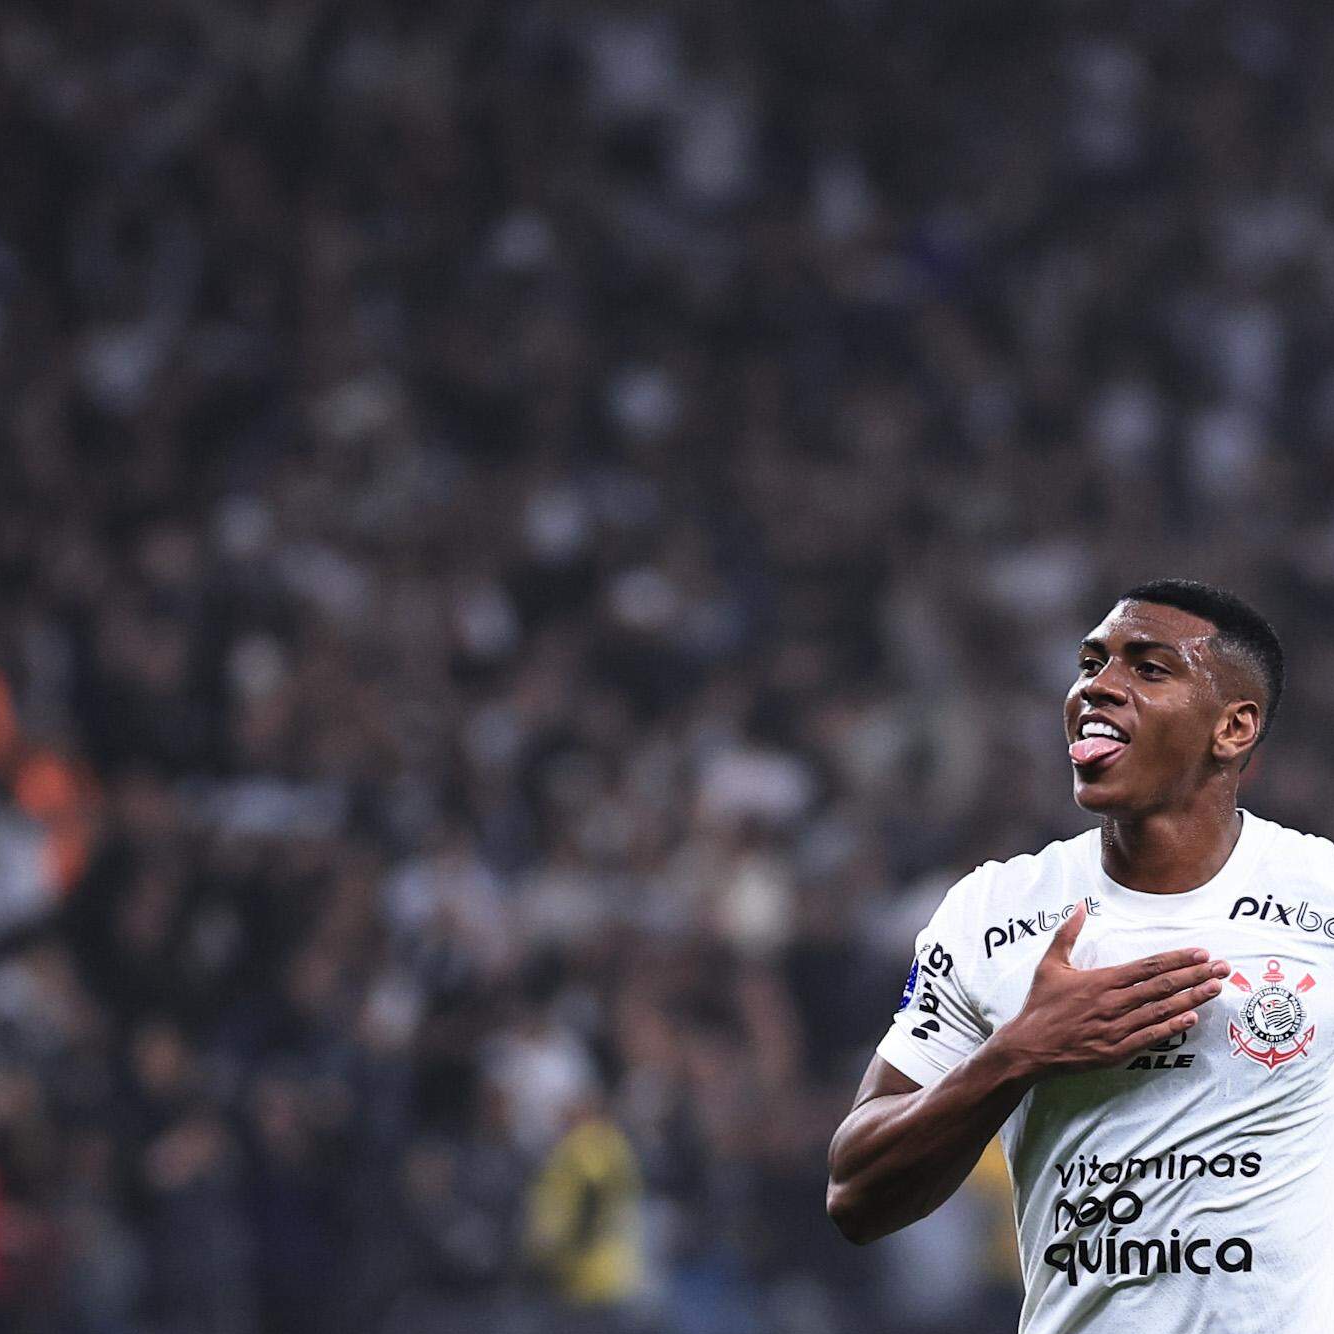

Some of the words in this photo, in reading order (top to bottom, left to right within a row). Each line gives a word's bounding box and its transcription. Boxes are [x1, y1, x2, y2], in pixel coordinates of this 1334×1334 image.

[1265, 1034, 1284, 1042] 1910
[1126, 1053, 1196, 1071] ALE
[1055, 1146, 1263, 1189] vitaminas
[1055, 1189, 1144, 1235] neo
[1043, 1226, 1254, 1287] química
